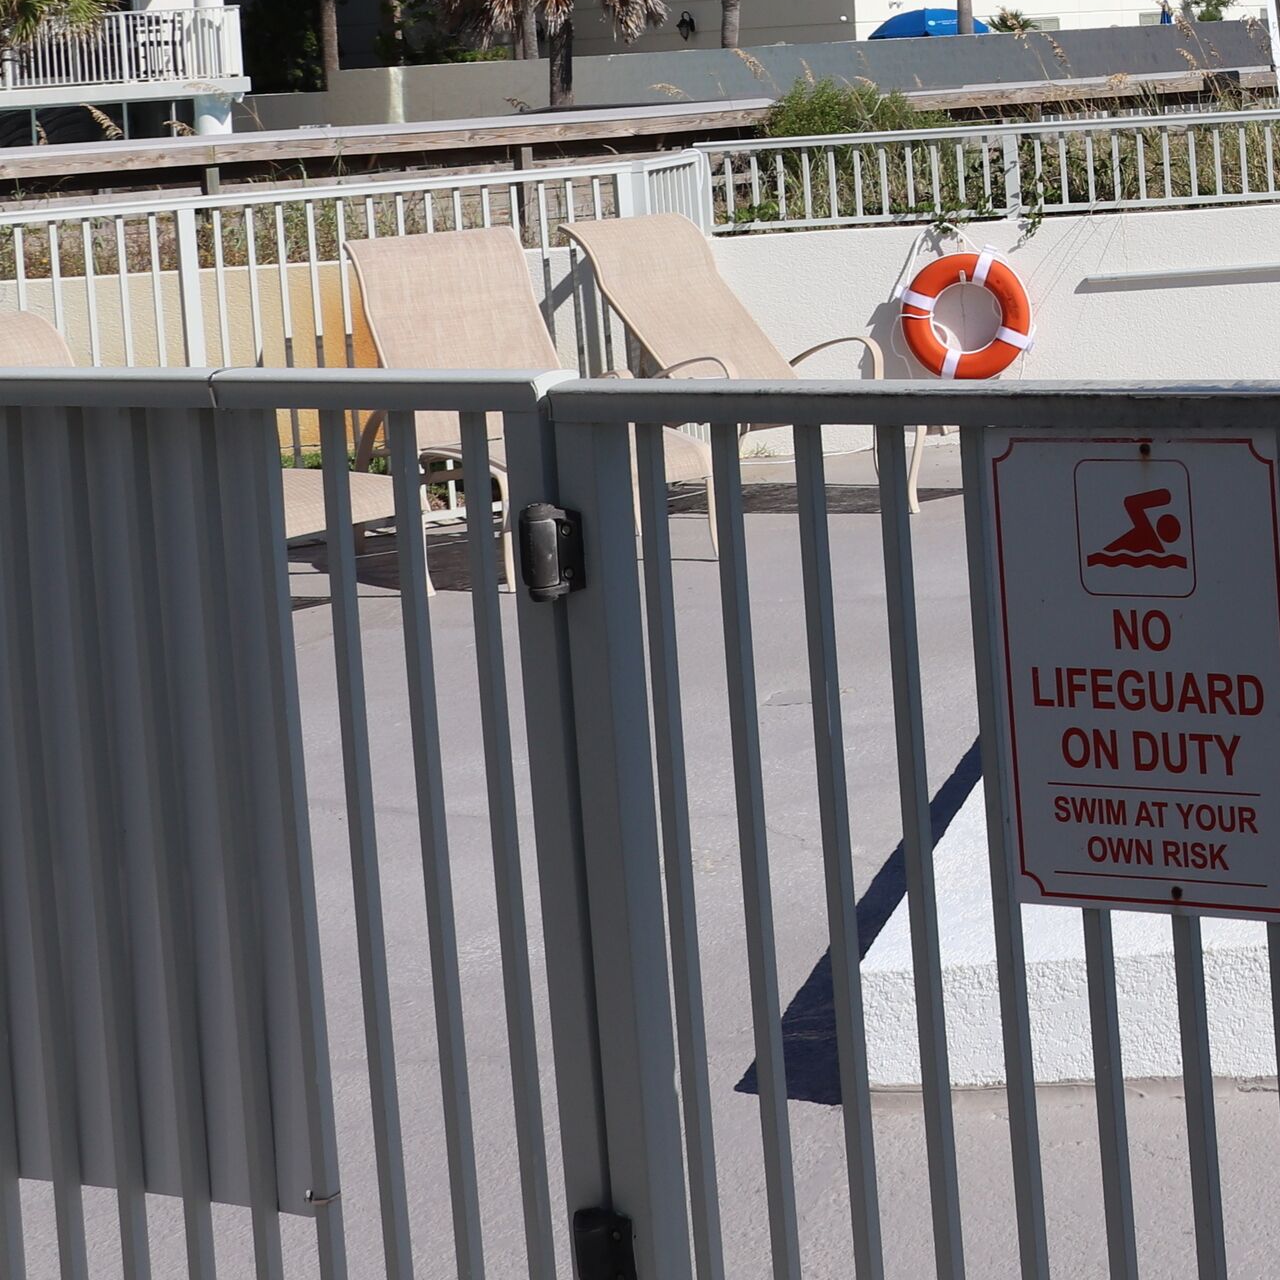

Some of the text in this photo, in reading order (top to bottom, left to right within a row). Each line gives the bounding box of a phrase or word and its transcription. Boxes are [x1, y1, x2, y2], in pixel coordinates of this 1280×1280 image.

[1112, 608, 1171, 652] NO
[1032, 667, 1265, 717] LIFEGUARD
[1062, 727, 1242, 777] ON DUTY
[1053, 795, 1259, 835] SWIM AT YOUR
[1086, 835, 1230, 871] OWN RISK
